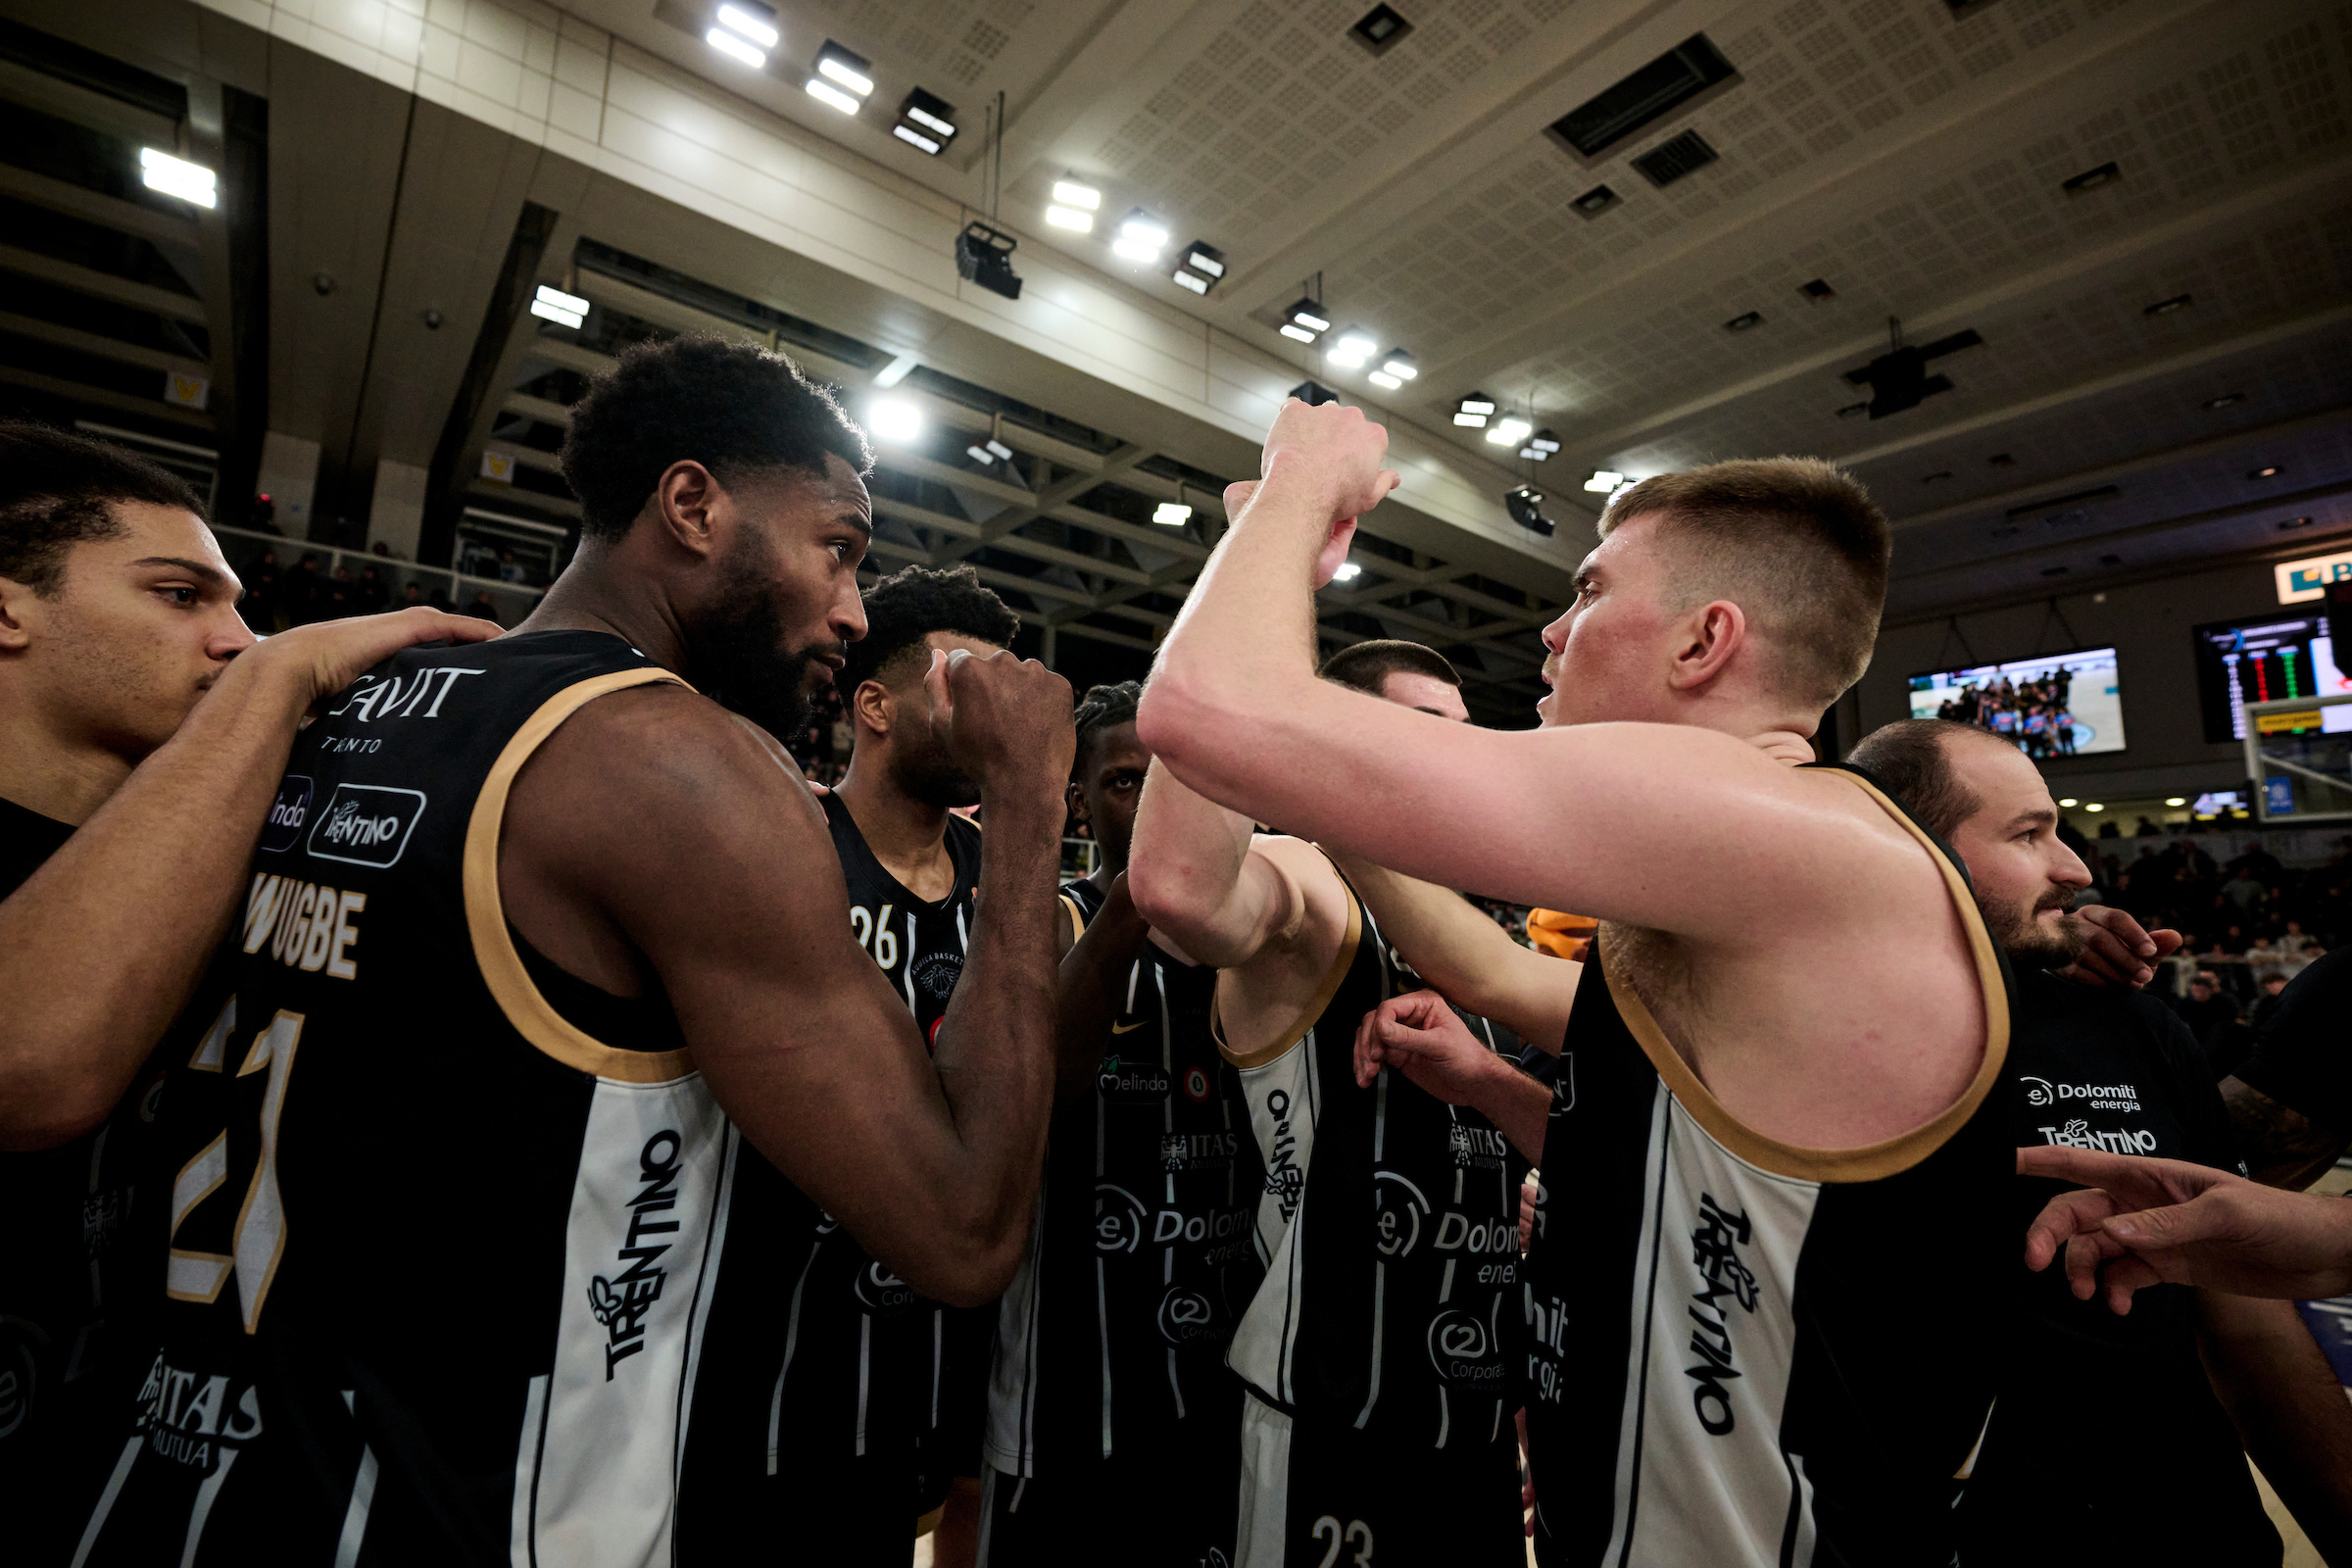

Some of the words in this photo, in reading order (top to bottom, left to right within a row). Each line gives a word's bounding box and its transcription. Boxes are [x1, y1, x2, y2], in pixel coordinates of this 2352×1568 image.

[269, 792, 307, 828] inda
[242, 871, 368, 980] WUGBE
[850, 904, 899, 970] 26
[911, 955, 934, 976] AQUILA
[1100, 1072, 1168, 1092] Melinda
[2058, 1083, 2137, 1100] Dolomiti
[2089, 1100, 2141, 1112] energia
[1191, 1133, 1239, 1157] ITAS
[1468, 1127, 1507, 1157] ITAS
[166, 992, 307, 1336] 21
[1152, 1207, 1253, 1244] Dolom
[1433, 1211, 1519, 1254] Dolom
[606, 1129, 684, 1383] TRENTINO
[155, 1363, 265, 1442] ITAS
[152, 1424, 211, 1469] MUTUA
[1312, 1514, 1374, 1568] 23
